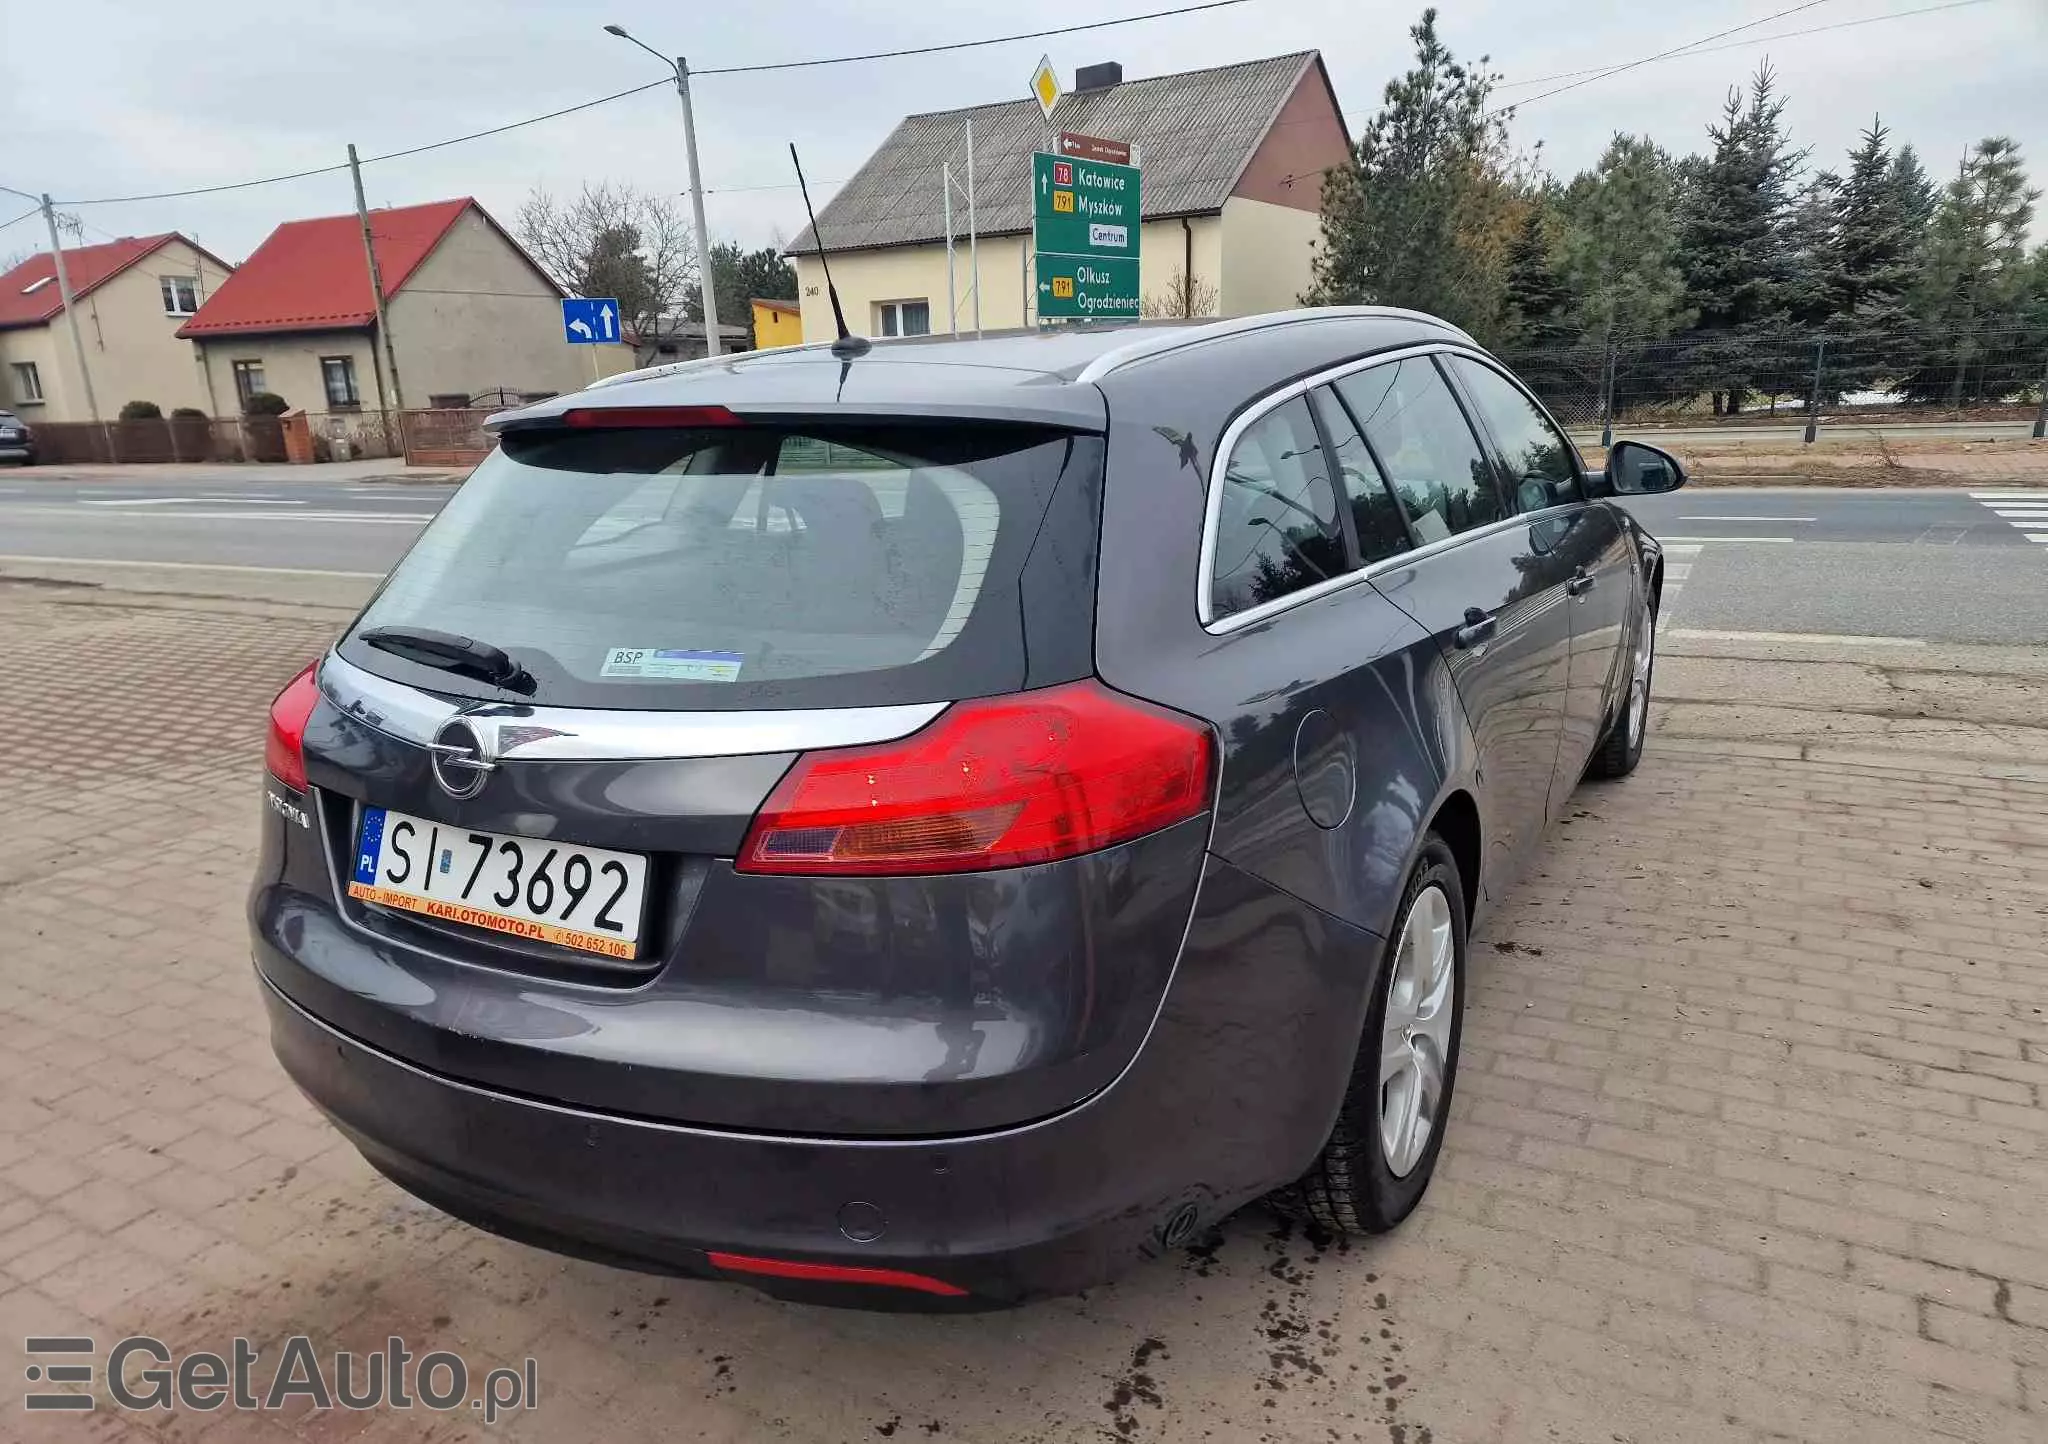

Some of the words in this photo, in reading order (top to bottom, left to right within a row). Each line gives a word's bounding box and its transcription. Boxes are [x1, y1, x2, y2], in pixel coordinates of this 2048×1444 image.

[1058, 168, 1069, 183] 78
[1078, 168, 1125, 190] Katowice
[1056, 195, 1071, 209] 791
[1078, 195, 1123, 218] Myszków
[1092, 228, 1125, 243] Centrum
[1077, 266, 1110, 284] Olkusz
[1055, 280, 1071, 294] 791
[1078, 292, 1139, 313] Ogrodzieniec
[614, 651, 644, 665] BSP
[360, 854, 375, 873] PL
[386, 820, 438, 891] SI
[461, 833, 629, 932] 73692
[353, 885, 377, 899] AUTO
[383, 891, 417, 910] IMPORT
[426, 901, 545, 939] KARI.OTOMOTO.PL
[565, 932, 584, 947] 502
[586, 936, 606, 953] 652
[609, 940, 627, 957] 106
